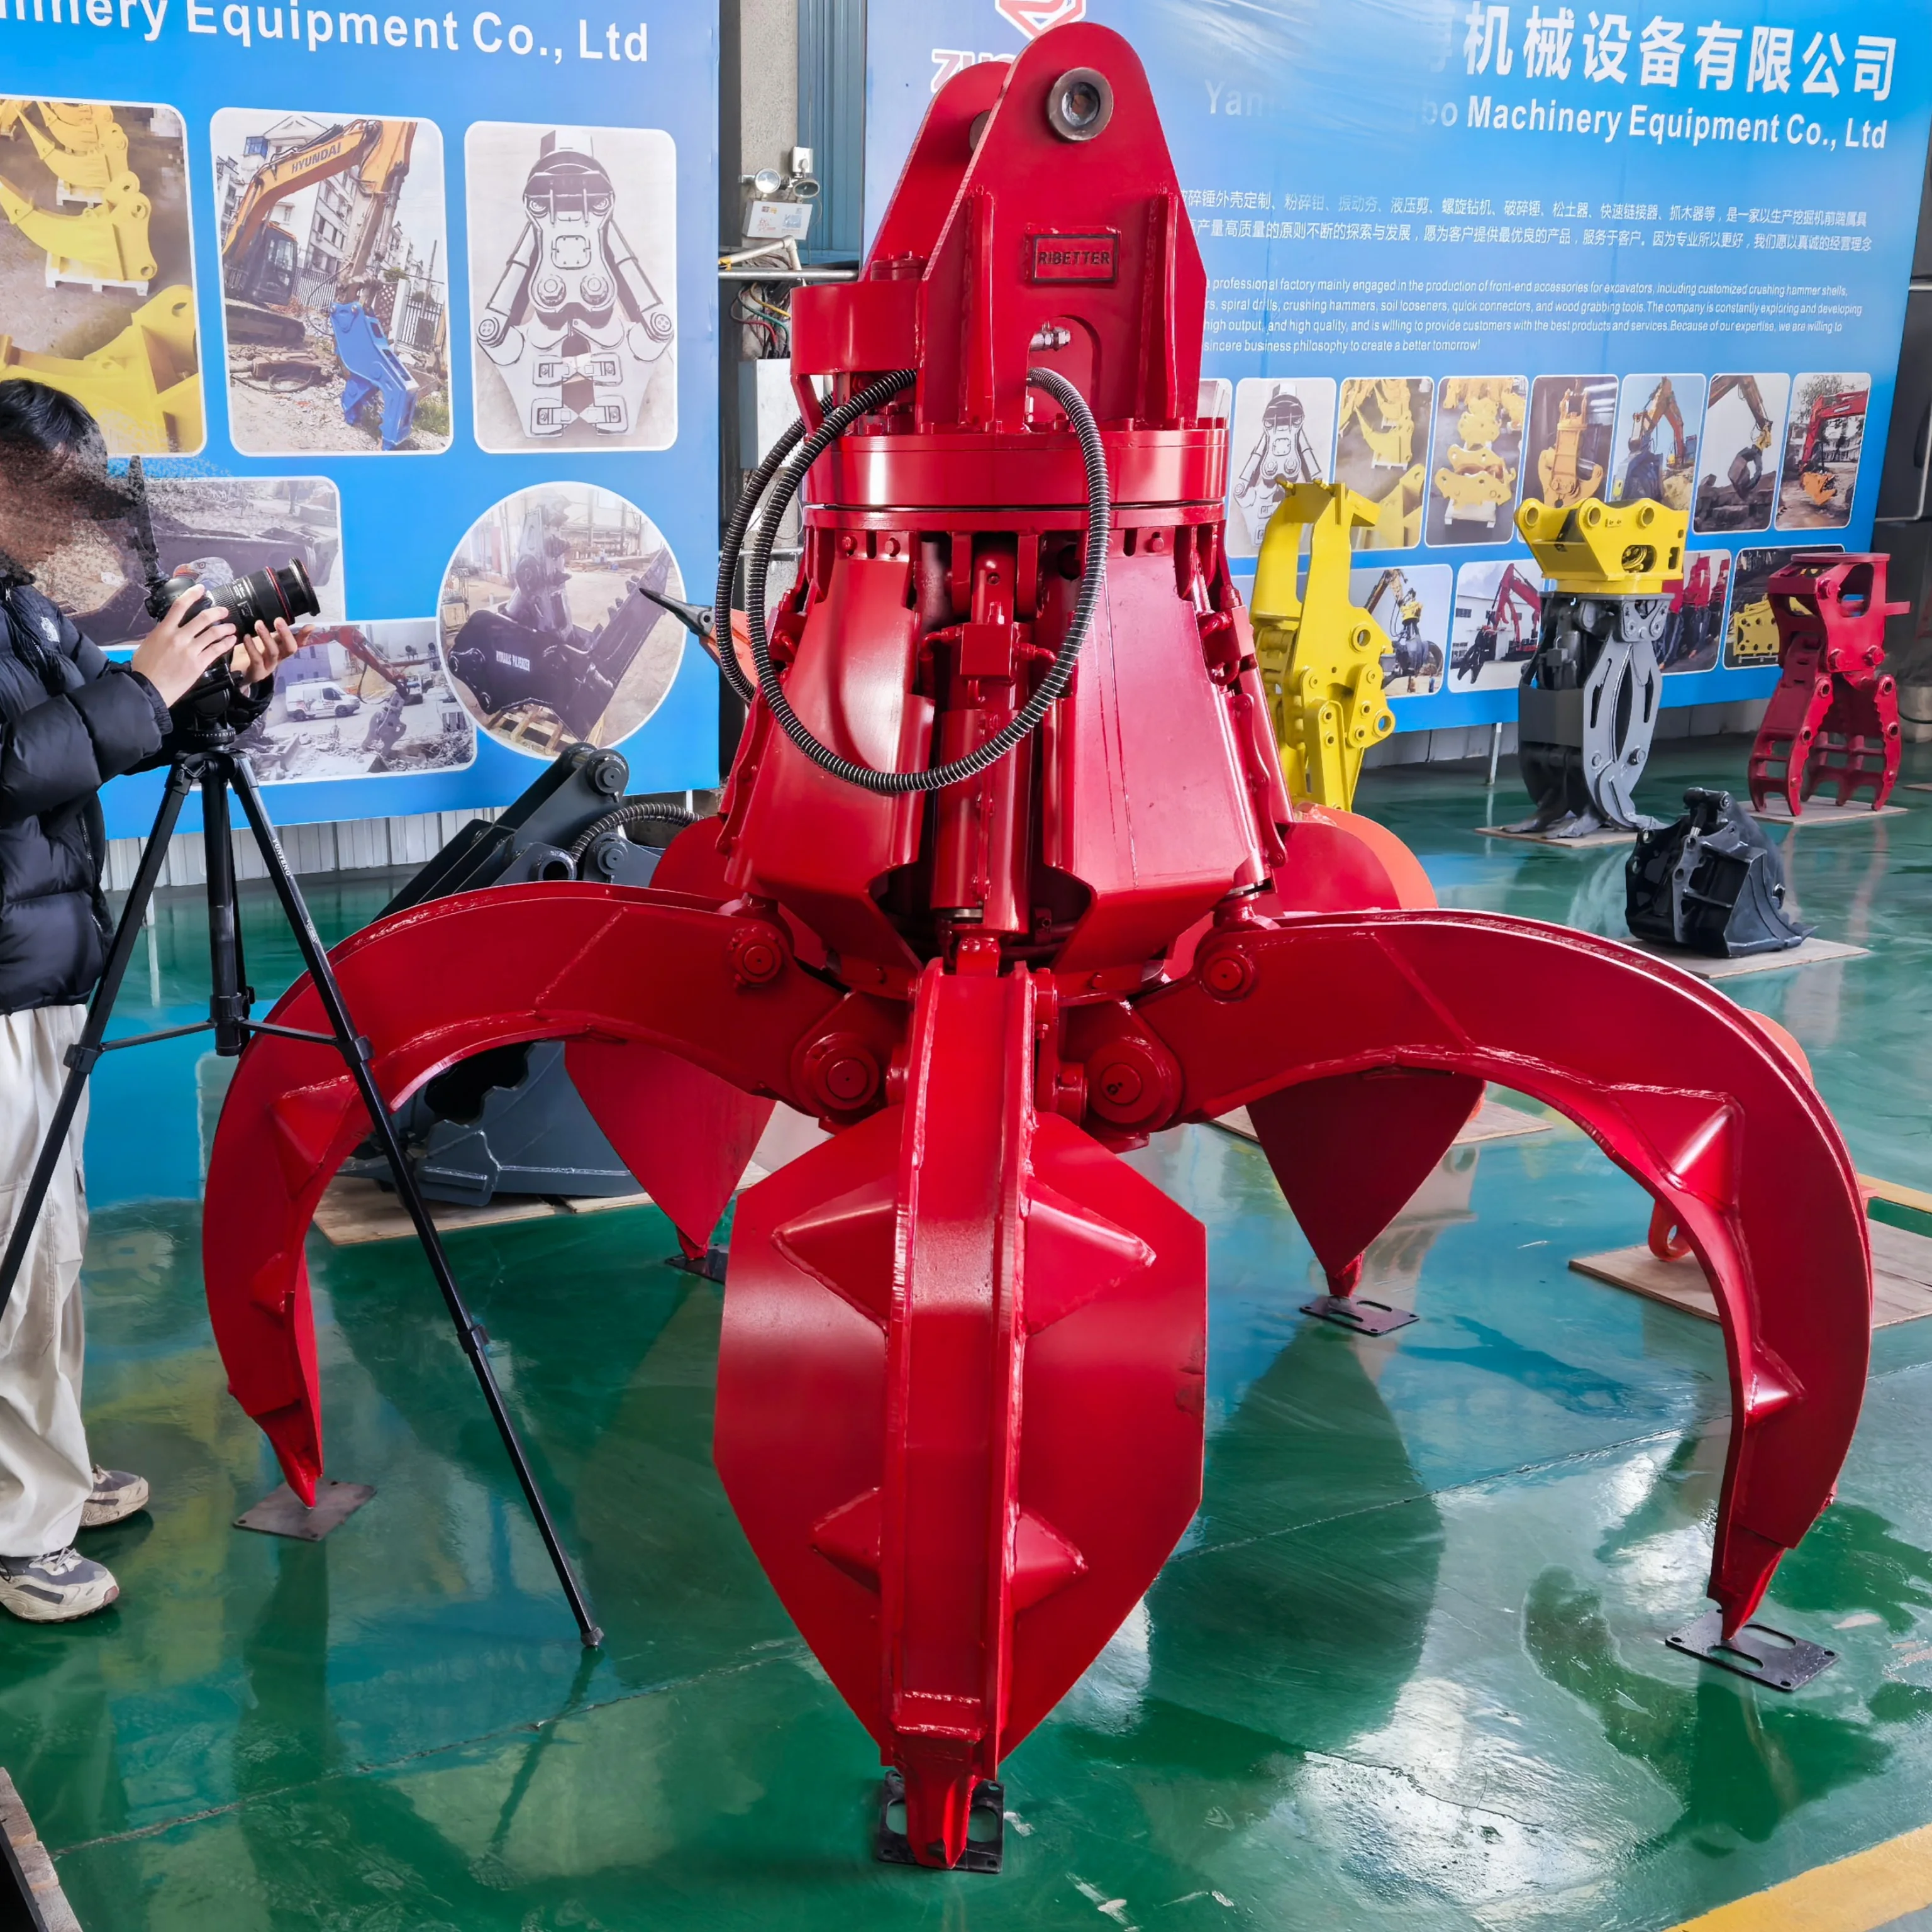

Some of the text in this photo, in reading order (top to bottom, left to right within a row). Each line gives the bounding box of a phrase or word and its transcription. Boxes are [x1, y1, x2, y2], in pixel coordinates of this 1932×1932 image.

[188, 0, 458, 52] Equipment
[473, 11, 563, 64] Co.,
[579, 19, 648, 62] Ltd
[1467, 95, 1622, 144] Machinery
[1629, 104, 1779, 148] Equipment
[1785, 113, 1837, 152] Co.,
[1845, 117, 1887, 150] Ltd
[291, 142, 341, 174] HYUNDAI
[1038, 252, 1110, 265] RIBETTER
[1213, 277, 1278, 291] professional
[1280, 277, 1316, 293] factory
[1318, 279, 1351, 293] mainly
[1353, 280, 1396, 293] engaged
[1397, 280, 1407, 291] in
[1409, 280, 1424, 291] the
[1426, 280, 1476, 294] production
[1479, 280, 1489, 292] of
[1490, 280, 1532, 292] front-end
[1534, 281, 1588, 292] accessories
[1591, 281, 1603, 292] for
[1604, 282, 1655, 294] excavators,
[1657, 282, 1696, 297] including
[1698, 283, 1747, 296] customized
[1749, 284, 1785, 297] crushing
[1786, 284, 1820, 296] hammer
[1221, 298, 1250, 313] spiral
[1283, 299, 1326, 313] crushing
[1329, 299, 1379, 313] hammers,
[1381, 299, 1397, 311] soil
[1452, 300, 1477, 313] quick
[1479, 301, 1533, 313] connectors,
[1536, 300, 1553, 311] and
[1555, 300, 1579, 312] wood
[1581, 301, 1621, 314] grabbing
[1665, 303, 1704, 315] company
[1706, 302, 1714, 313] is
[1716, 303, 1759, 315] constantly
[1761, 303, 1799, 316] exploring
[1801, 303, 1816, 314] and
[1818, 303, 1862, 316] developing
[1268, 320, 1287, 331] and
[1289, 319, 1311, 334] high
[1351, 319, 1369, 331] and
[1372, 320, 1379, 331] is
[1382, 319, 1412, 334] willing
[1414, 320, 1423, 331] to
[1425, 319, 1461, 333] provide
[1463, 320, 1511, 331] customers
[1514, 319, 1532, 331] with
[1535, 319, 1548, 331] the
[1550, 319, 1570, 331] best
[1572, 319, 1611, 333] products
[1613, 319, 1629, 331] and
[1710, 319, 1719, 331] of
[1719, 321, 1734, 331] our
[1779, 321, 1790, 331] we
[1792, 322, 1806, 331] are
[1807, 320, 1833, 334] willing
[1834, 321, 1843, 331] to
[1204, 339, 1480, 353] sincere business philosophy to create a better tomorrow!
